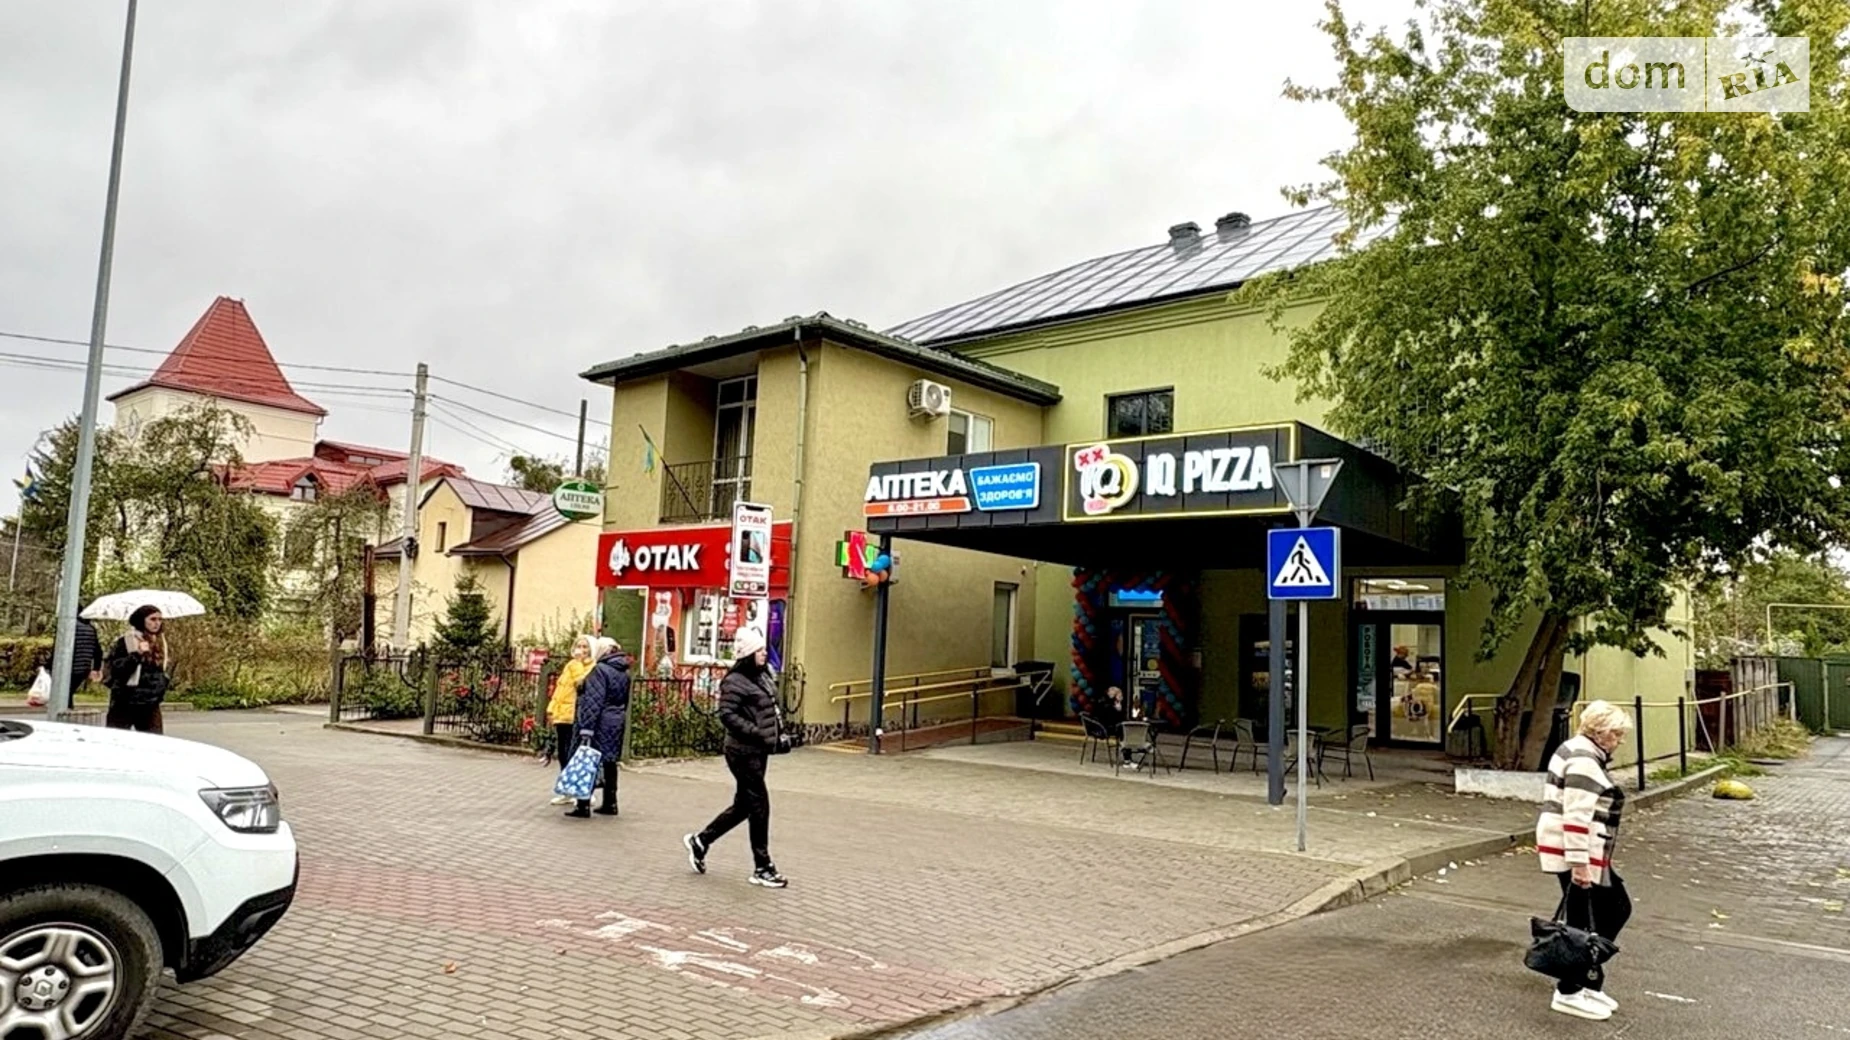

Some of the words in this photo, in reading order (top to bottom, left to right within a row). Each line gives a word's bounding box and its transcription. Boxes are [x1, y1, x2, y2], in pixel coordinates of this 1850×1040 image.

[1146, 453, 1176, 496] IQ
[1183, 446, 1273, 493] PIZZA
[560, 491, 601, 506] АПТЕКА
[864, 469, 968, 501] АПТЕКА
[739, 515, 767, 524] ОТАК
[634, 544, 700, 571] ОТАК
